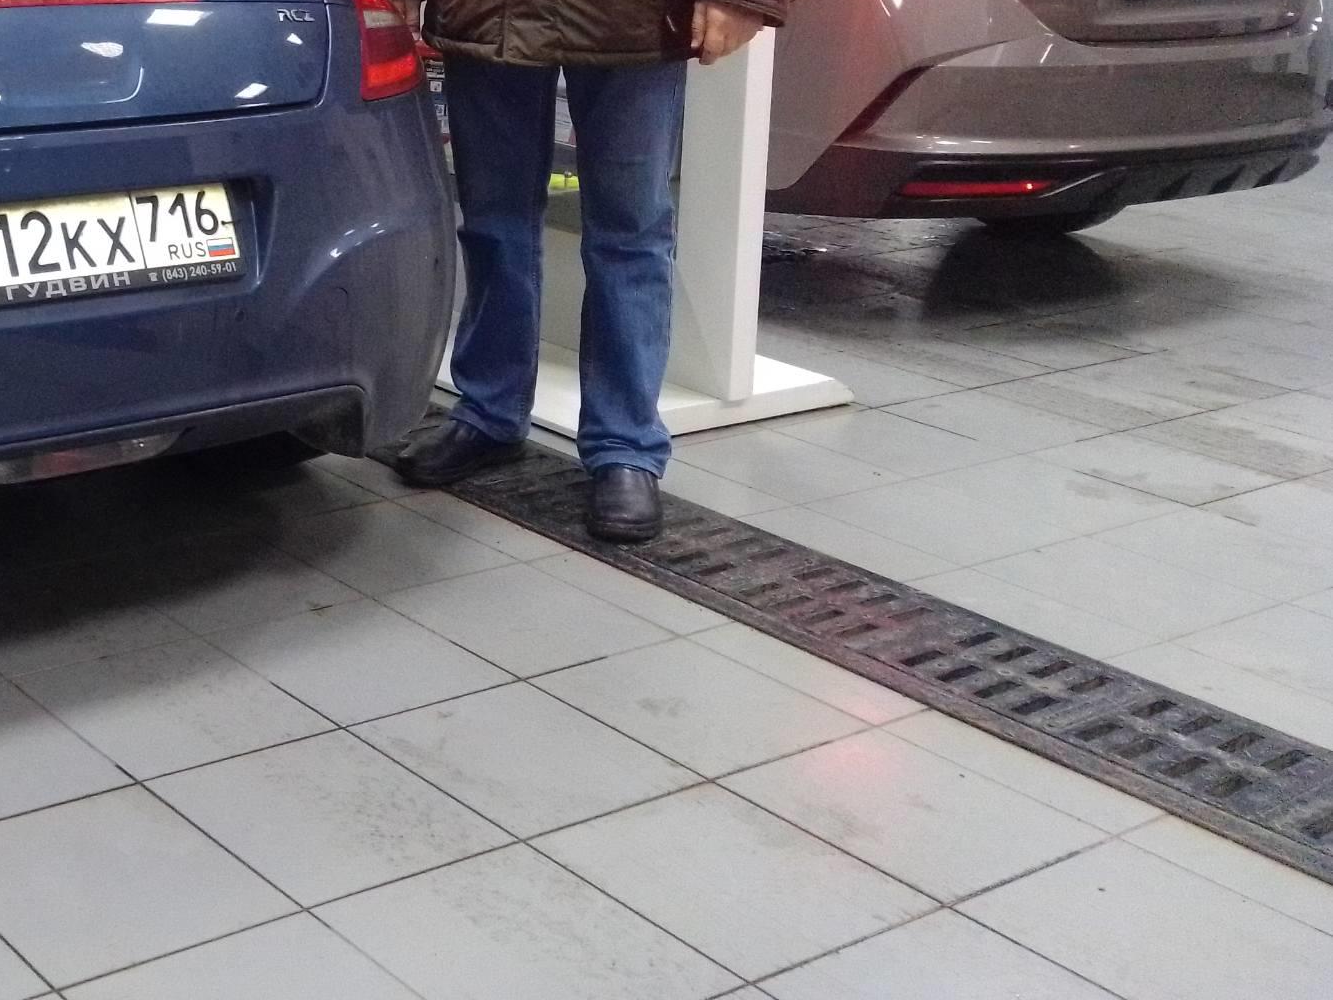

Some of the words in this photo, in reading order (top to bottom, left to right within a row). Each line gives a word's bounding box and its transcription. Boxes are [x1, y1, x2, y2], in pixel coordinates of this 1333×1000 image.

[135, 190, 219, 243] 716
[167, 241, 207, 261] RUS
[5, 271, 132, 301] ГУДВИН
[161, 267, 188, 283] (843)
[190, 262, 237, 277] 240-59-01
